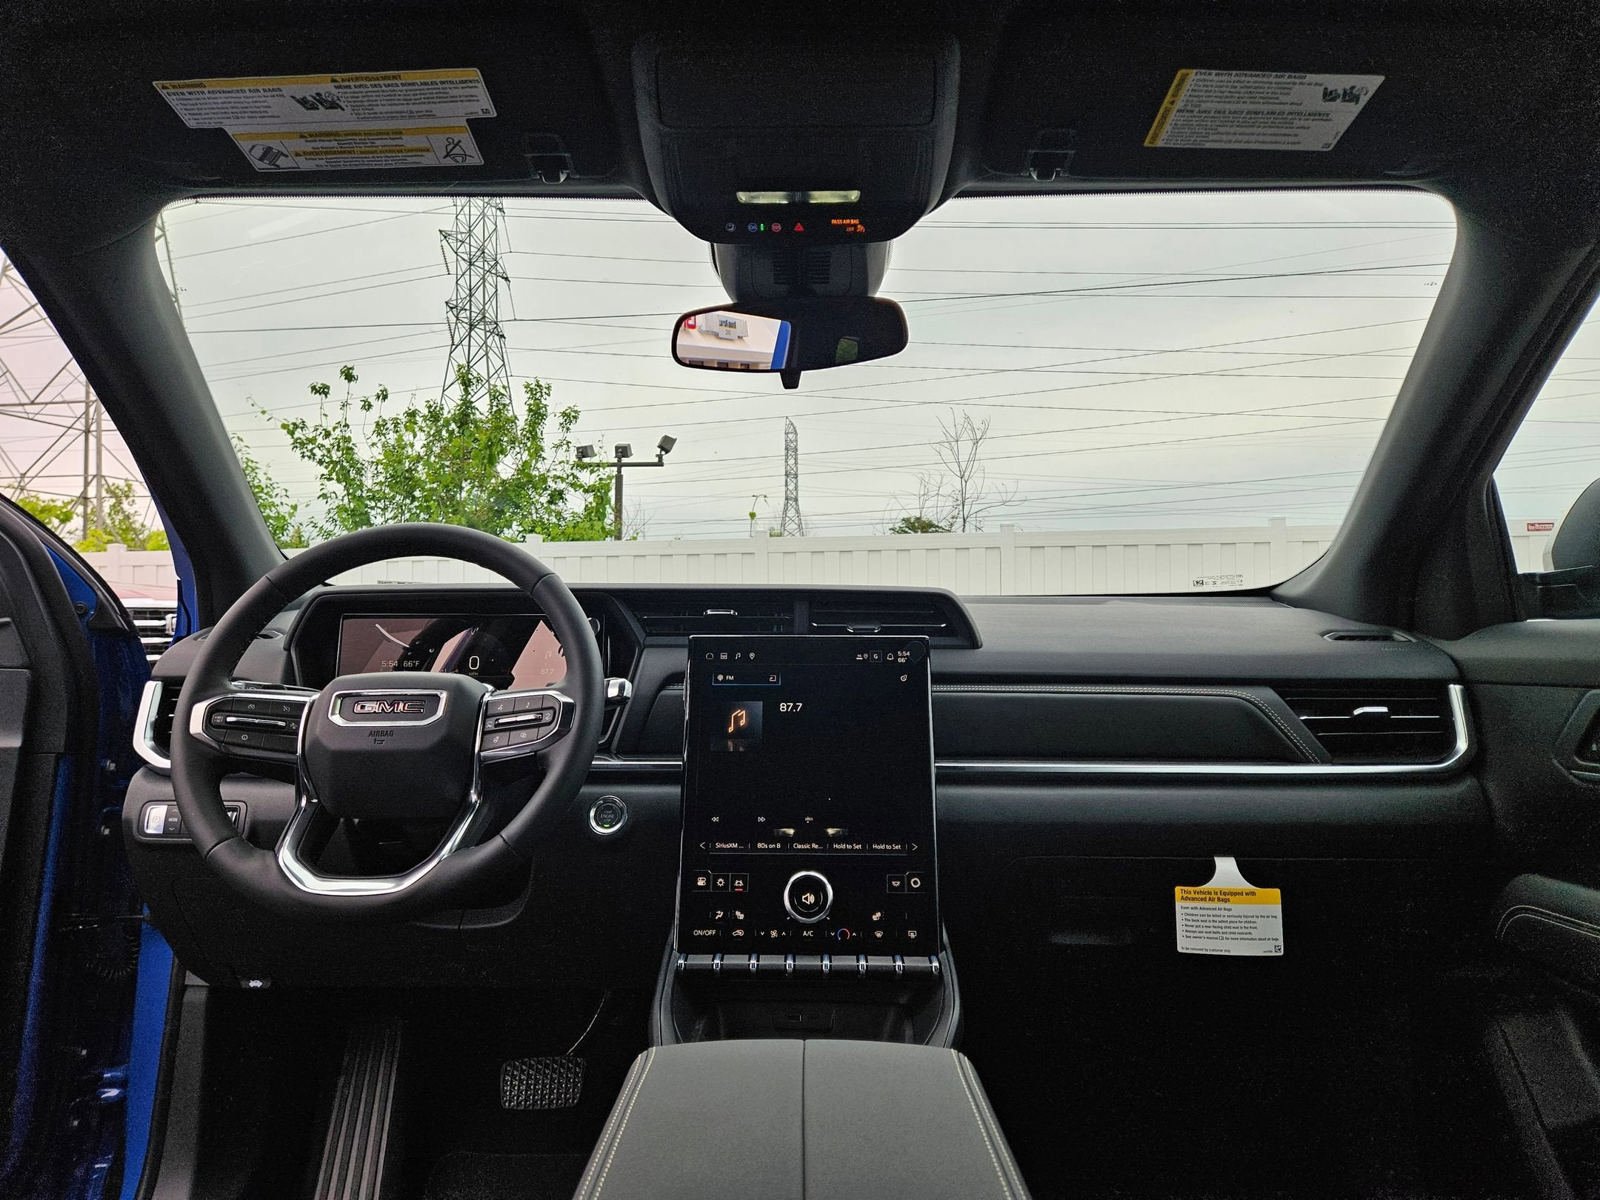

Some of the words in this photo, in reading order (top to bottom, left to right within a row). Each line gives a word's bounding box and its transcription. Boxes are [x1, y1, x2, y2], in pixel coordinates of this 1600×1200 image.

[469, 655, 479, 670] 0
[354, 700, 425, 714] GMC
[779, 702, 803, 712] 87.7
[368, 730, 394, 738] AIRBAG
